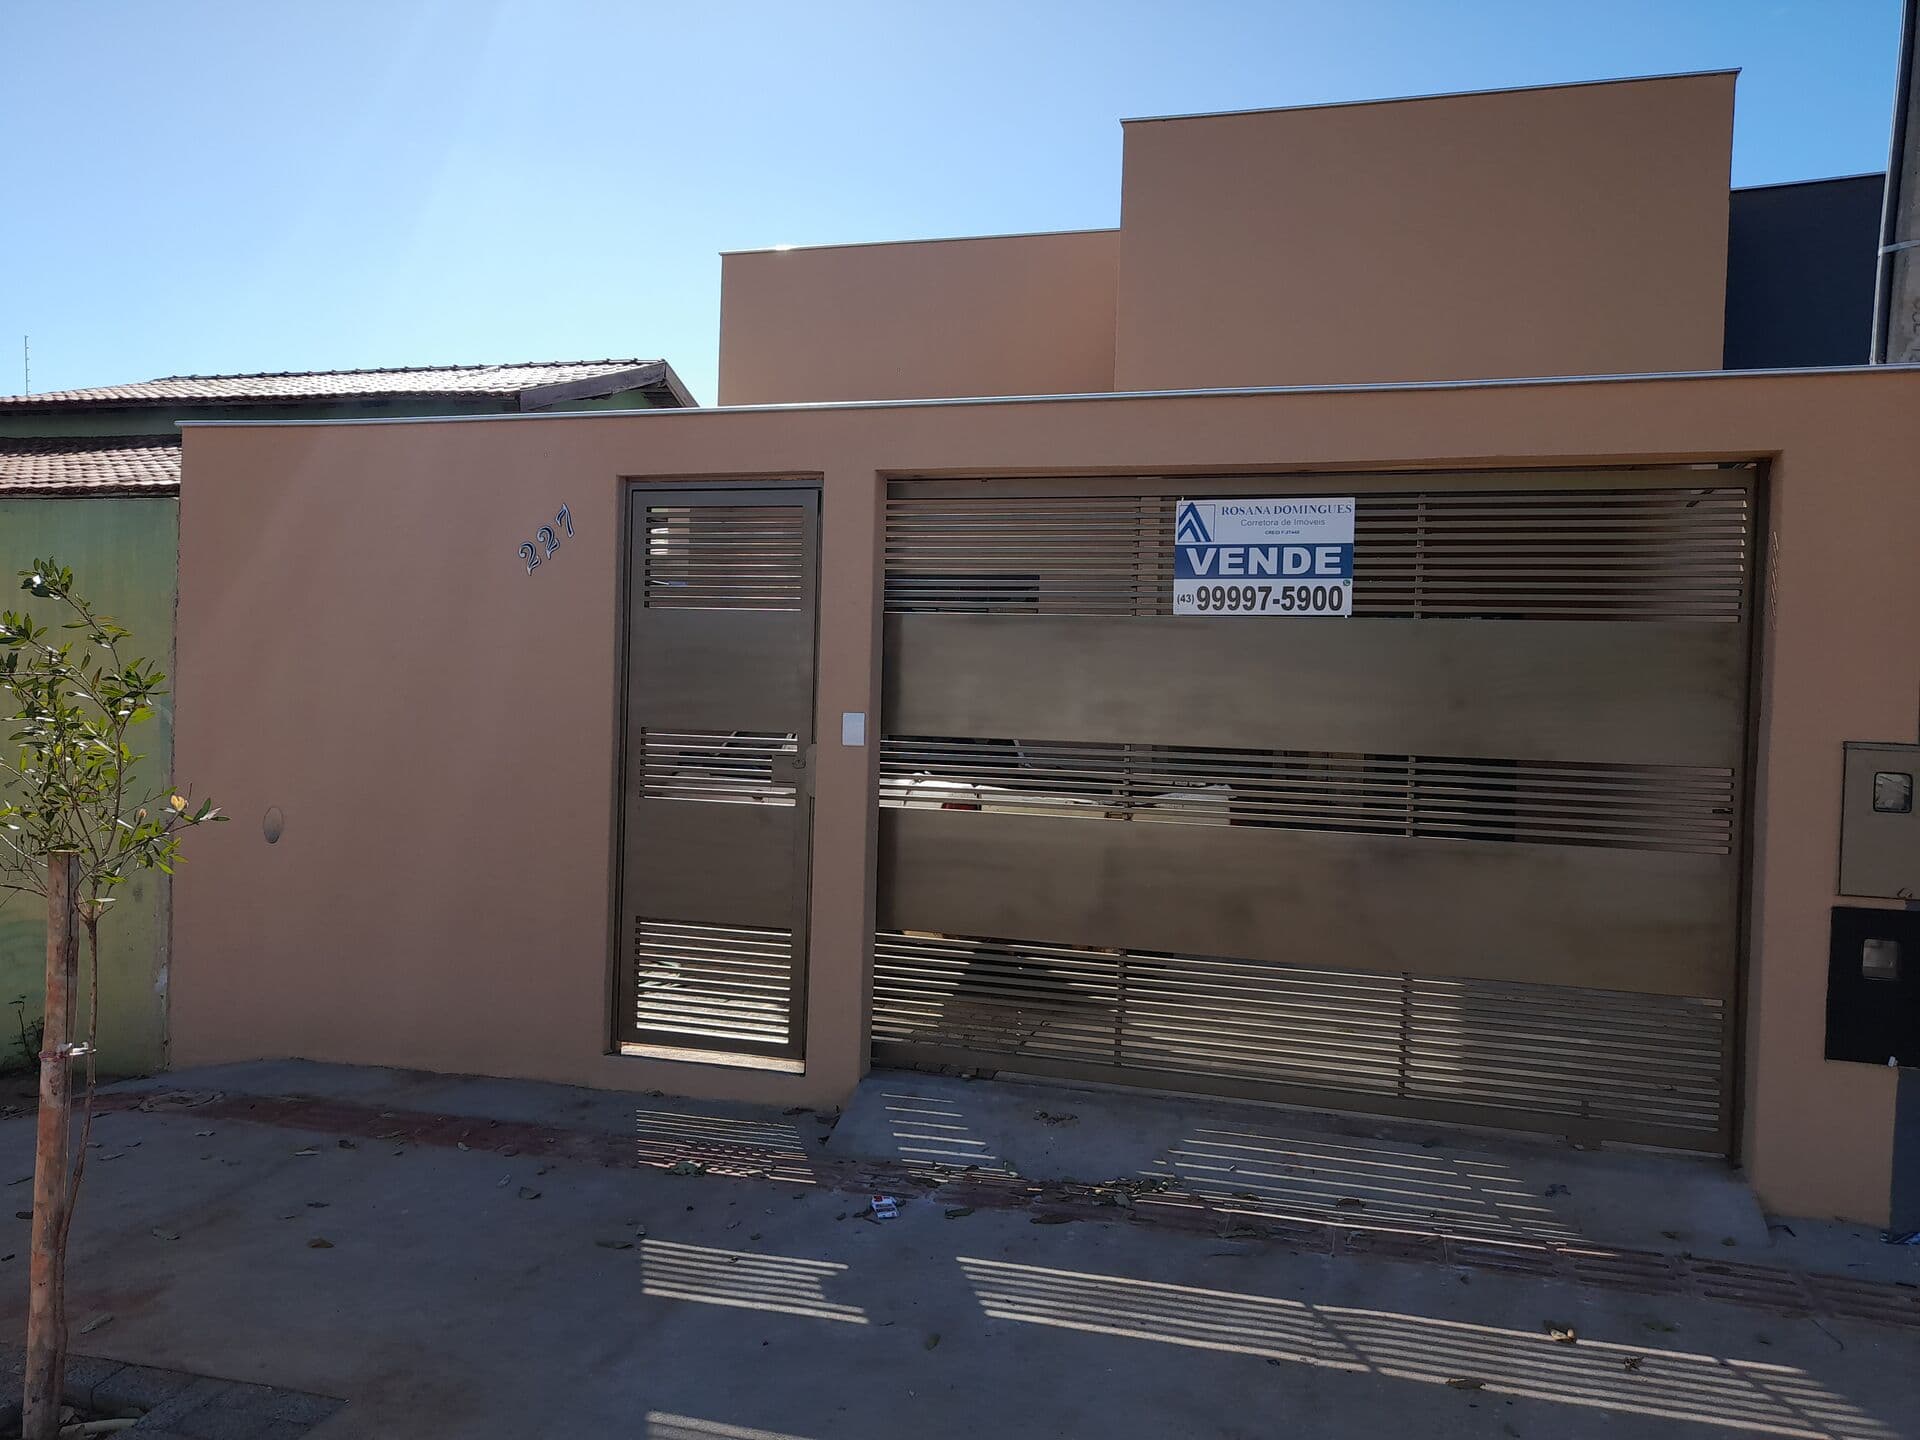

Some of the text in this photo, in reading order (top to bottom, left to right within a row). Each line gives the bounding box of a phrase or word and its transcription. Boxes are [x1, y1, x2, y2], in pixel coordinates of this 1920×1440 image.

[1221, 504, 1352, 516] ROSANA DOMINGUES
[1240, 519, 1279, 527] Corretora
[1281, 518, 1291, 526] de
[518, 502, 575, 576] 227
[1186, 546, 1342, 576] VENDE
[1176, 585, 1343, 611] (43) 99997-5900
